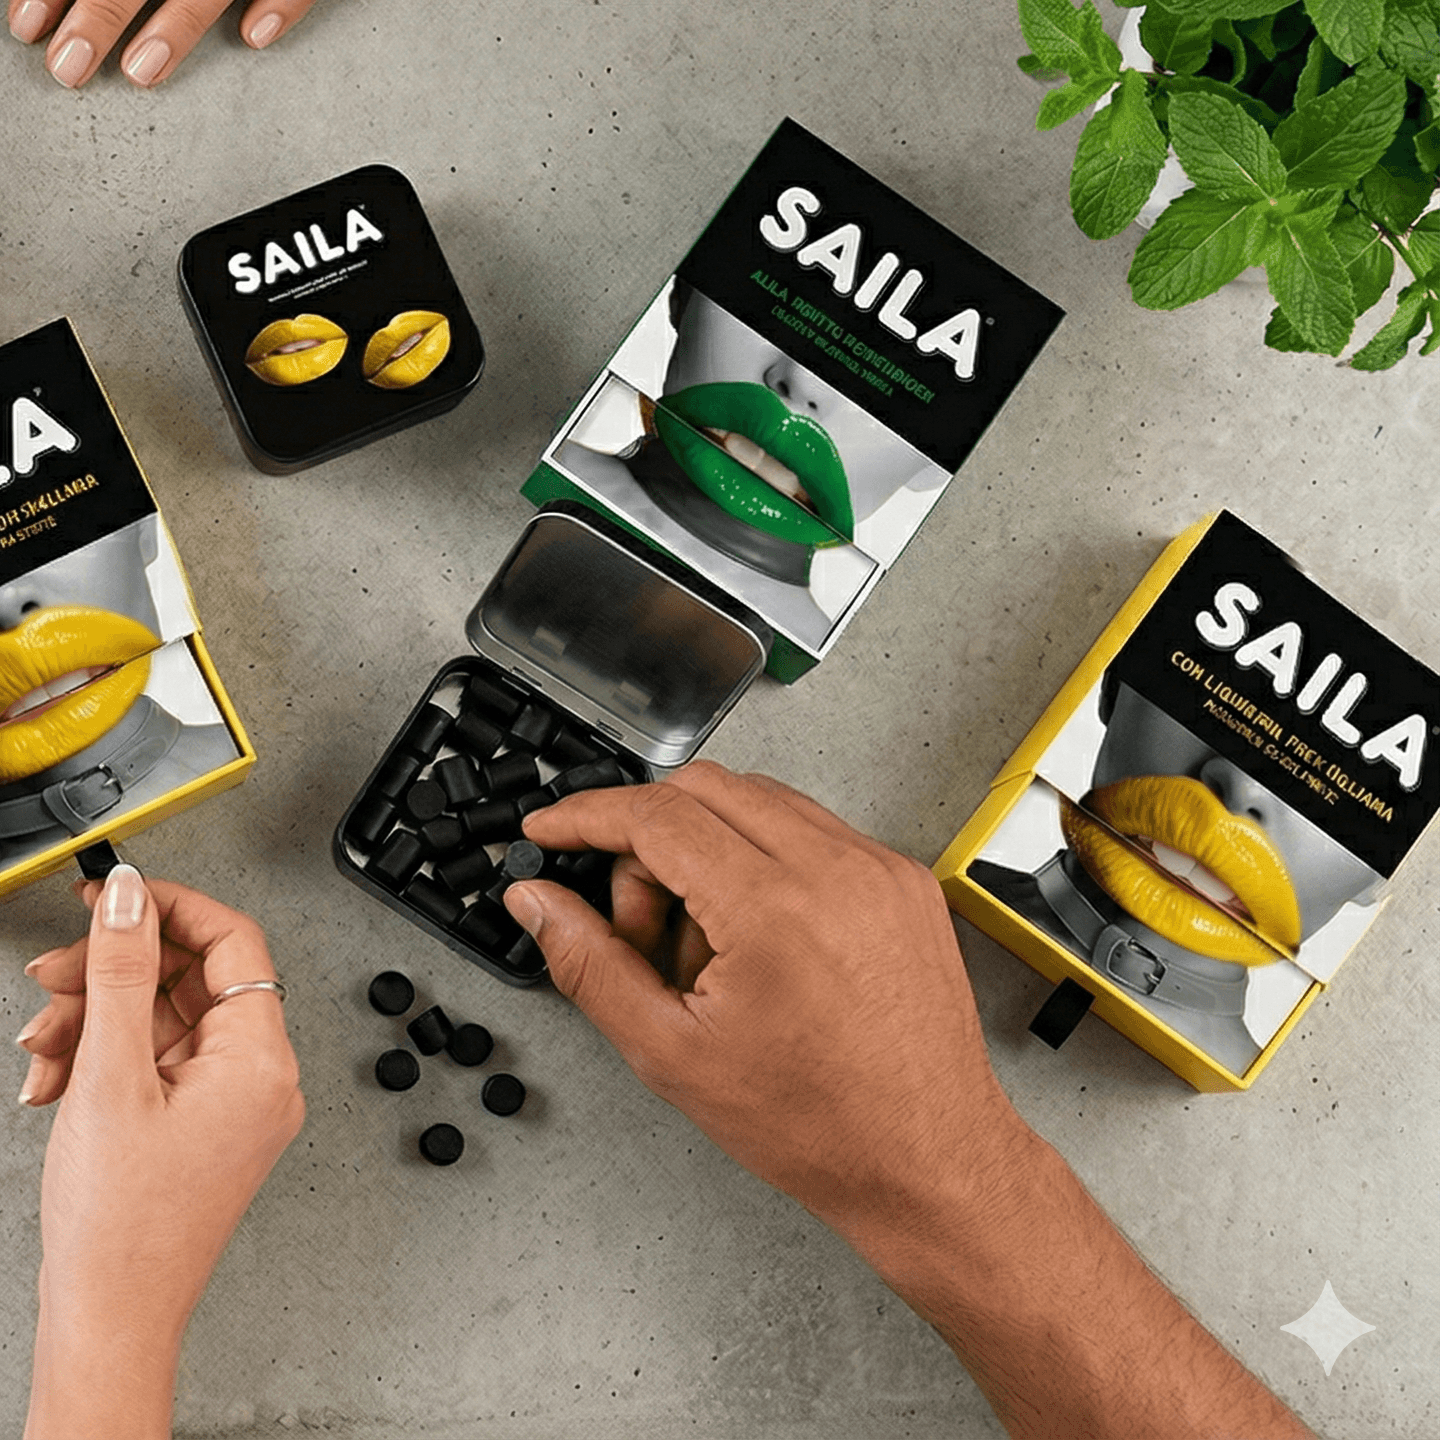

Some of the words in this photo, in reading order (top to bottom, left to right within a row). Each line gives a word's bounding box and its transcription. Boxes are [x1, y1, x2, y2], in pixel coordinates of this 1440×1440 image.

[228, 207, 384, 293] SAILA
[758, 185, 983, 381] SAILA
[1194, 581, 1429, 790] SAILA
